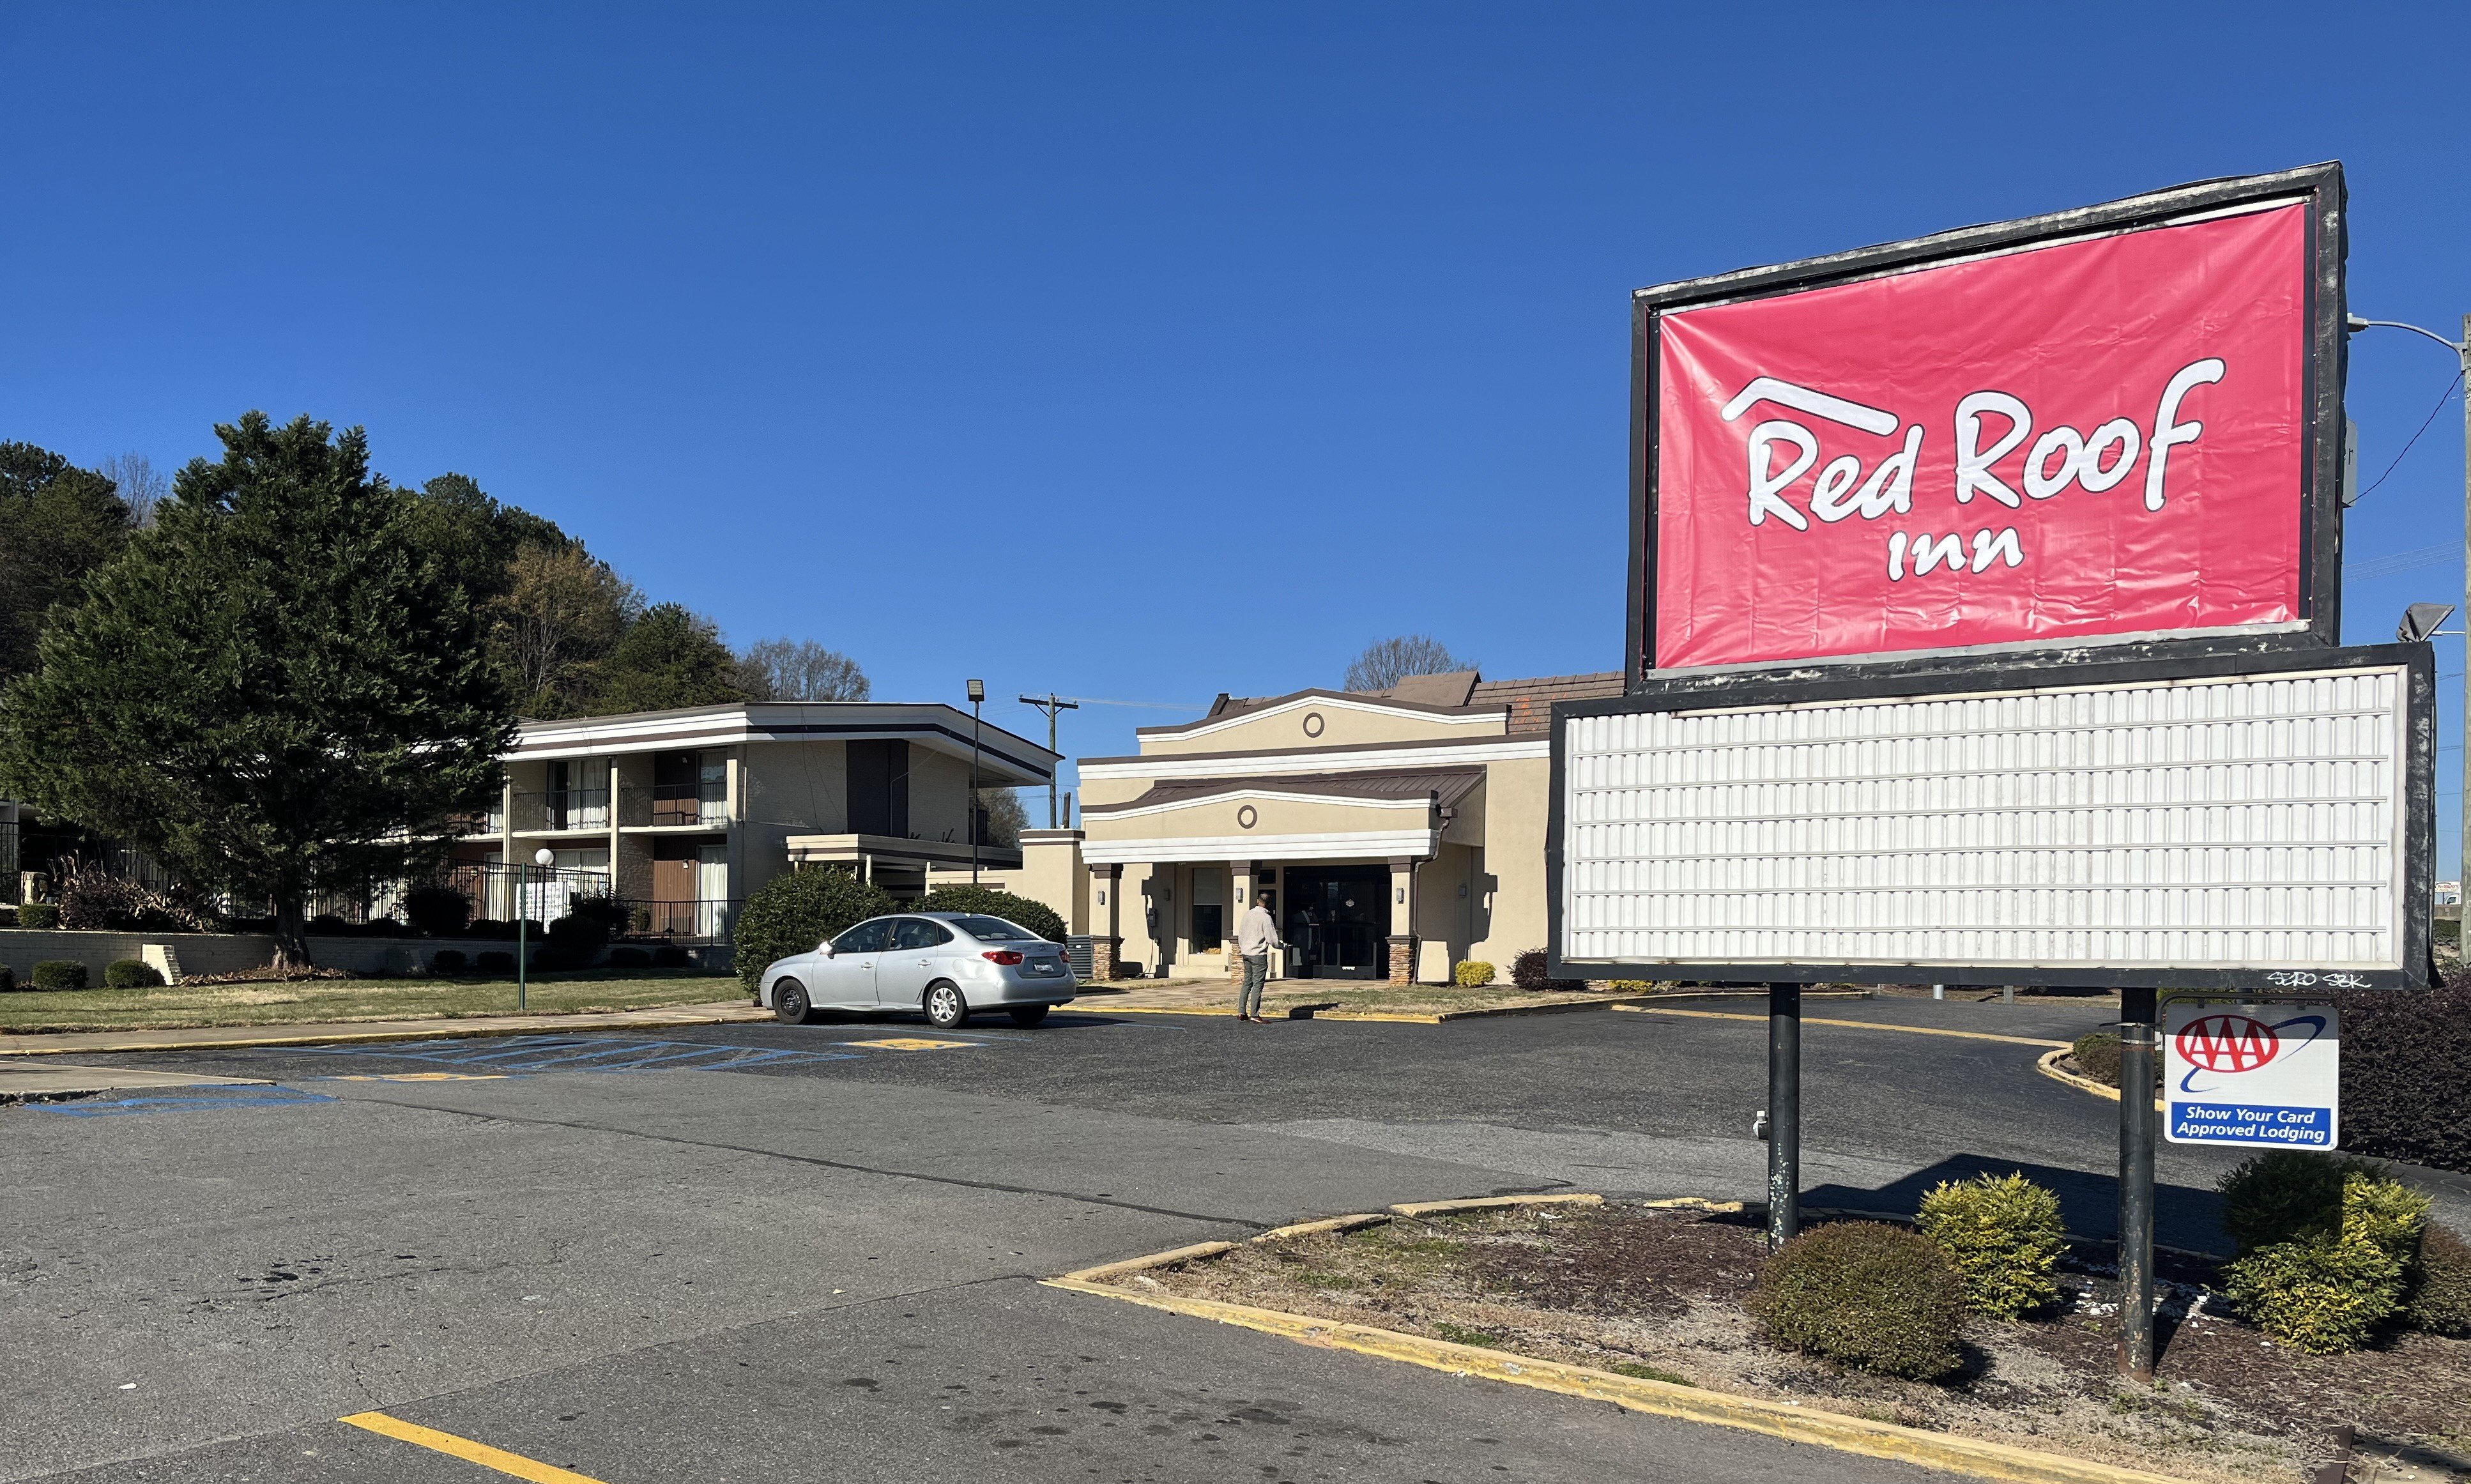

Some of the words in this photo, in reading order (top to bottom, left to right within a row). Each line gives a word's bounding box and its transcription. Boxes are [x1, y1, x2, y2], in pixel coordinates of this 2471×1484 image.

[1748, 419, 1924, 531] Red
[1954, 357, 2226, 511] Roof
[1886, 526, 2024, 581] inn
[2182, 1016, 2273, 1071] AAA
[2176, 1121, 2257, 1137] Approved
[2259, 1125, 2325, 1142] Lodging
[2185, 1106, 2231, 1121] Show
[2237, 1108, 2274, 1122] Your
[2277, 1110, 2316, 1124] Card
